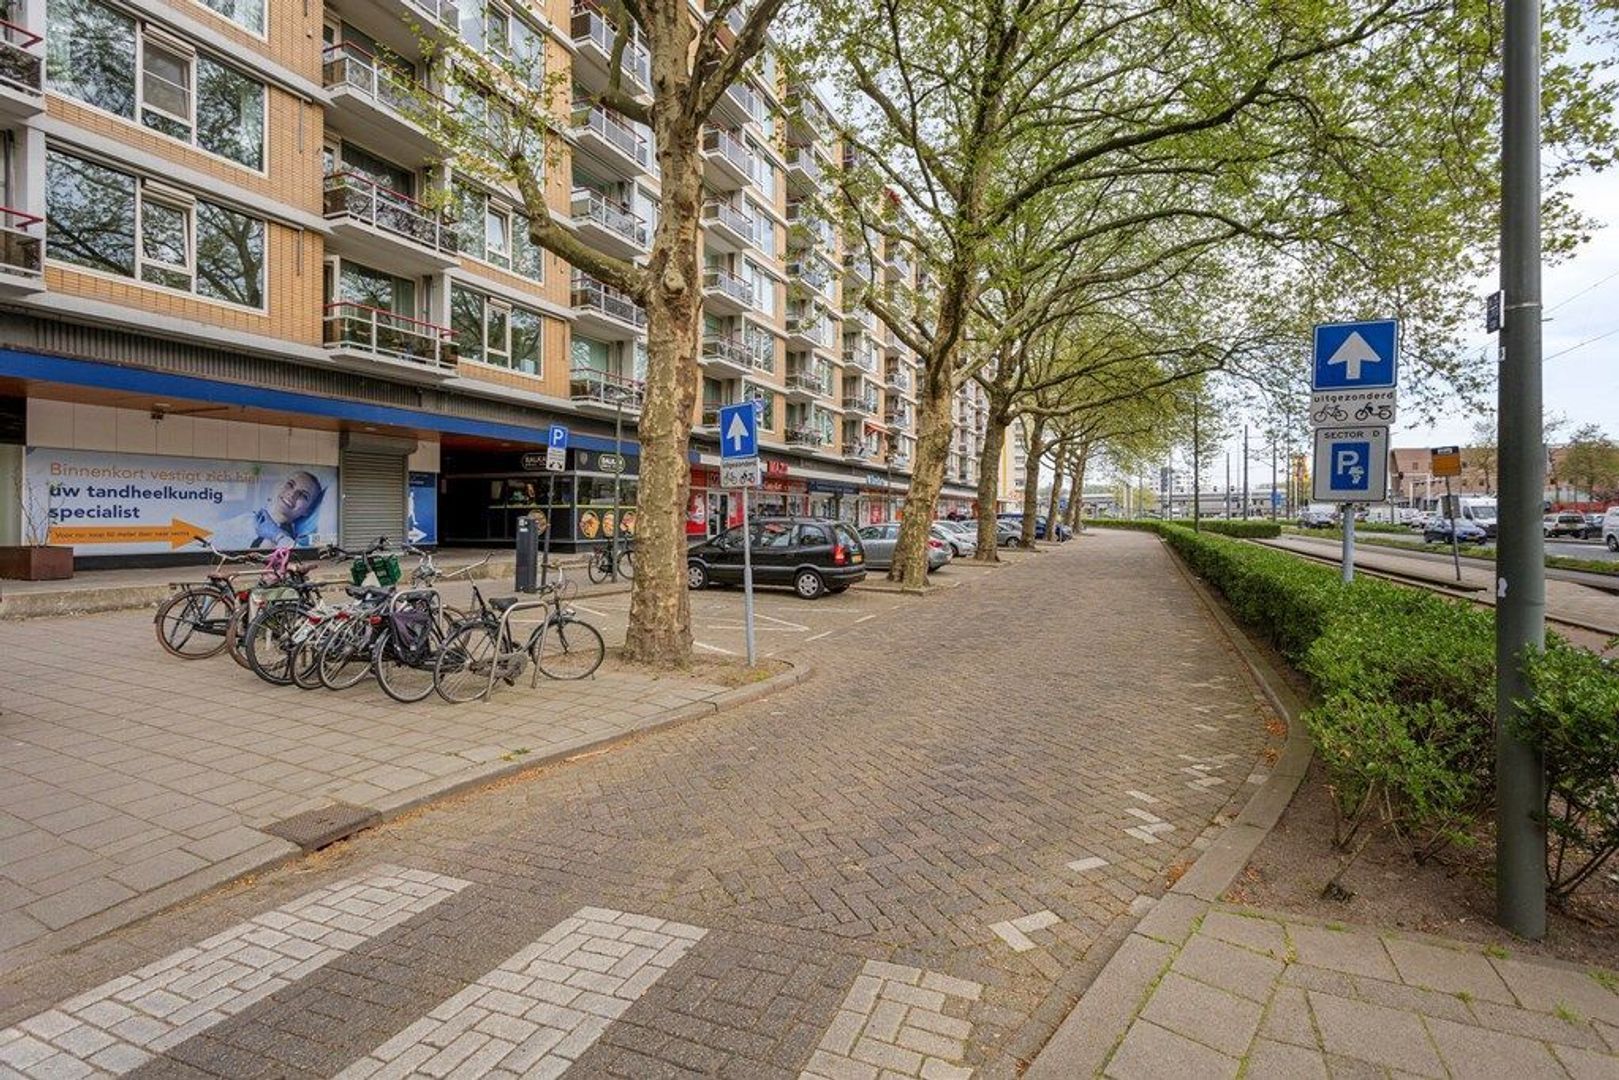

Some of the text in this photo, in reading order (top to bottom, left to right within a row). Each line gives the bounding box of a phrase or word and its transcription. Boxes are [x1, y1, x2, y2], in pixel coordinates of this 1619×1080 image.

[1314, 391, 1394, 403] uitgezonderd
[553, 428, 565, 446] P
[1324, 431, 1365, 439] SECTOR
[1337, 450, 1360, 475] P
[50, 463, 144, 479] Binnenkort
[150, 468, 201, 485] vestigt
[50, 484, 223, 504] uw tandheelkundig
[48, 505, 140, 522] specialist
